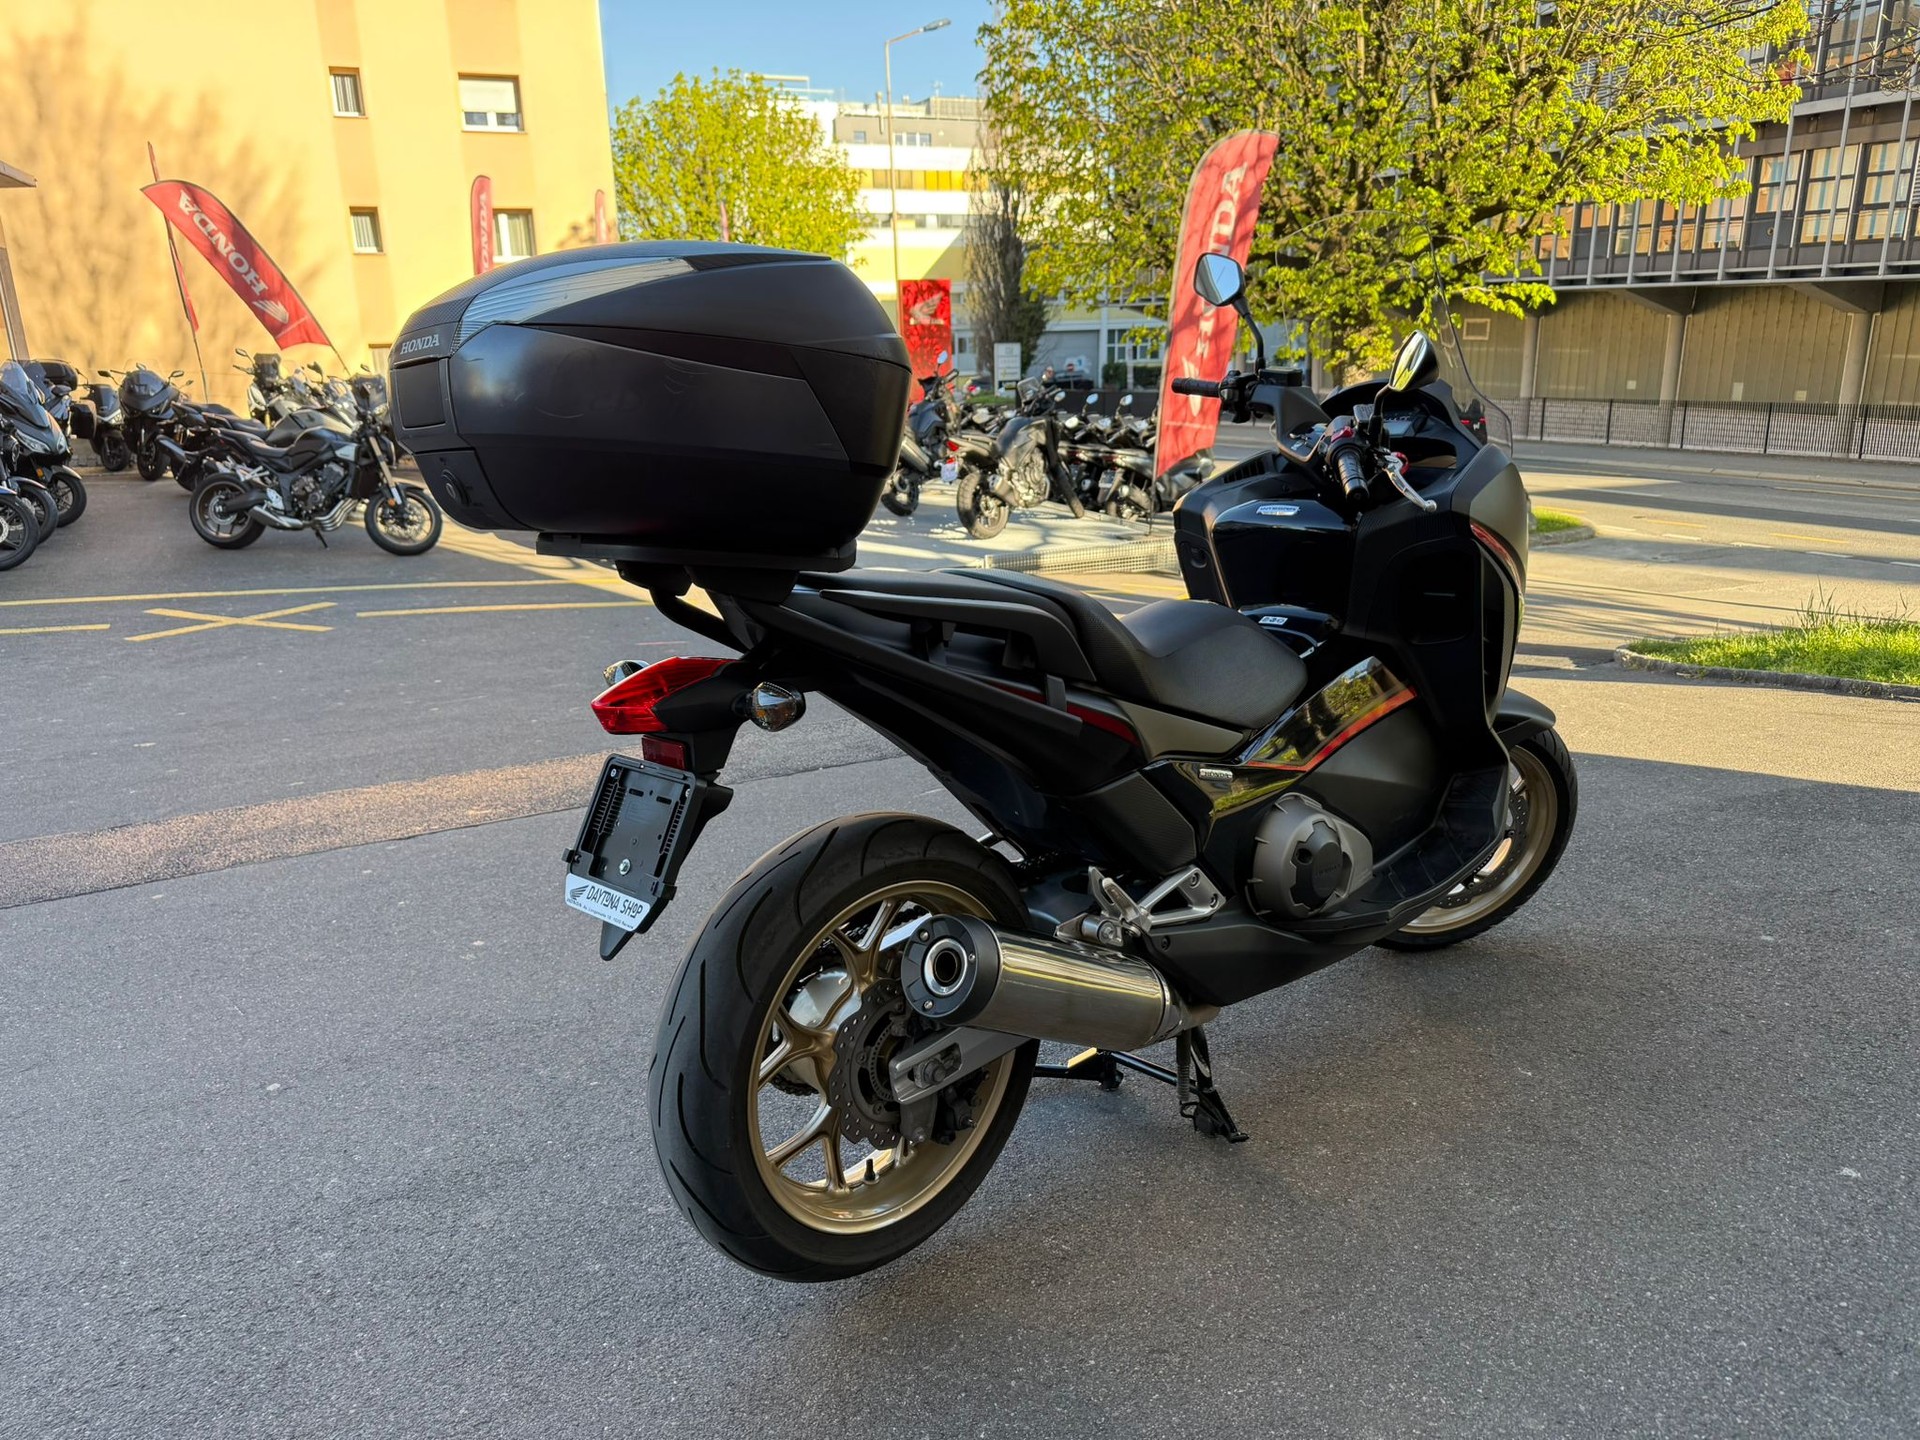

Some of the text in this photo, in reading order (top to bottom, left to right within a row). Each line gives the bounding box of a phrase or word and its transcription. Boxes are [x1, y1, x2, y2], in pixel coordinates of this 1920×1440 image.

[178, 189, 269, 296] HONDA
[400, 334, 440, 355] HONDA
[586, 885, 621, 912] DAYTONA
[620, 898, 643, 918] SHOP
